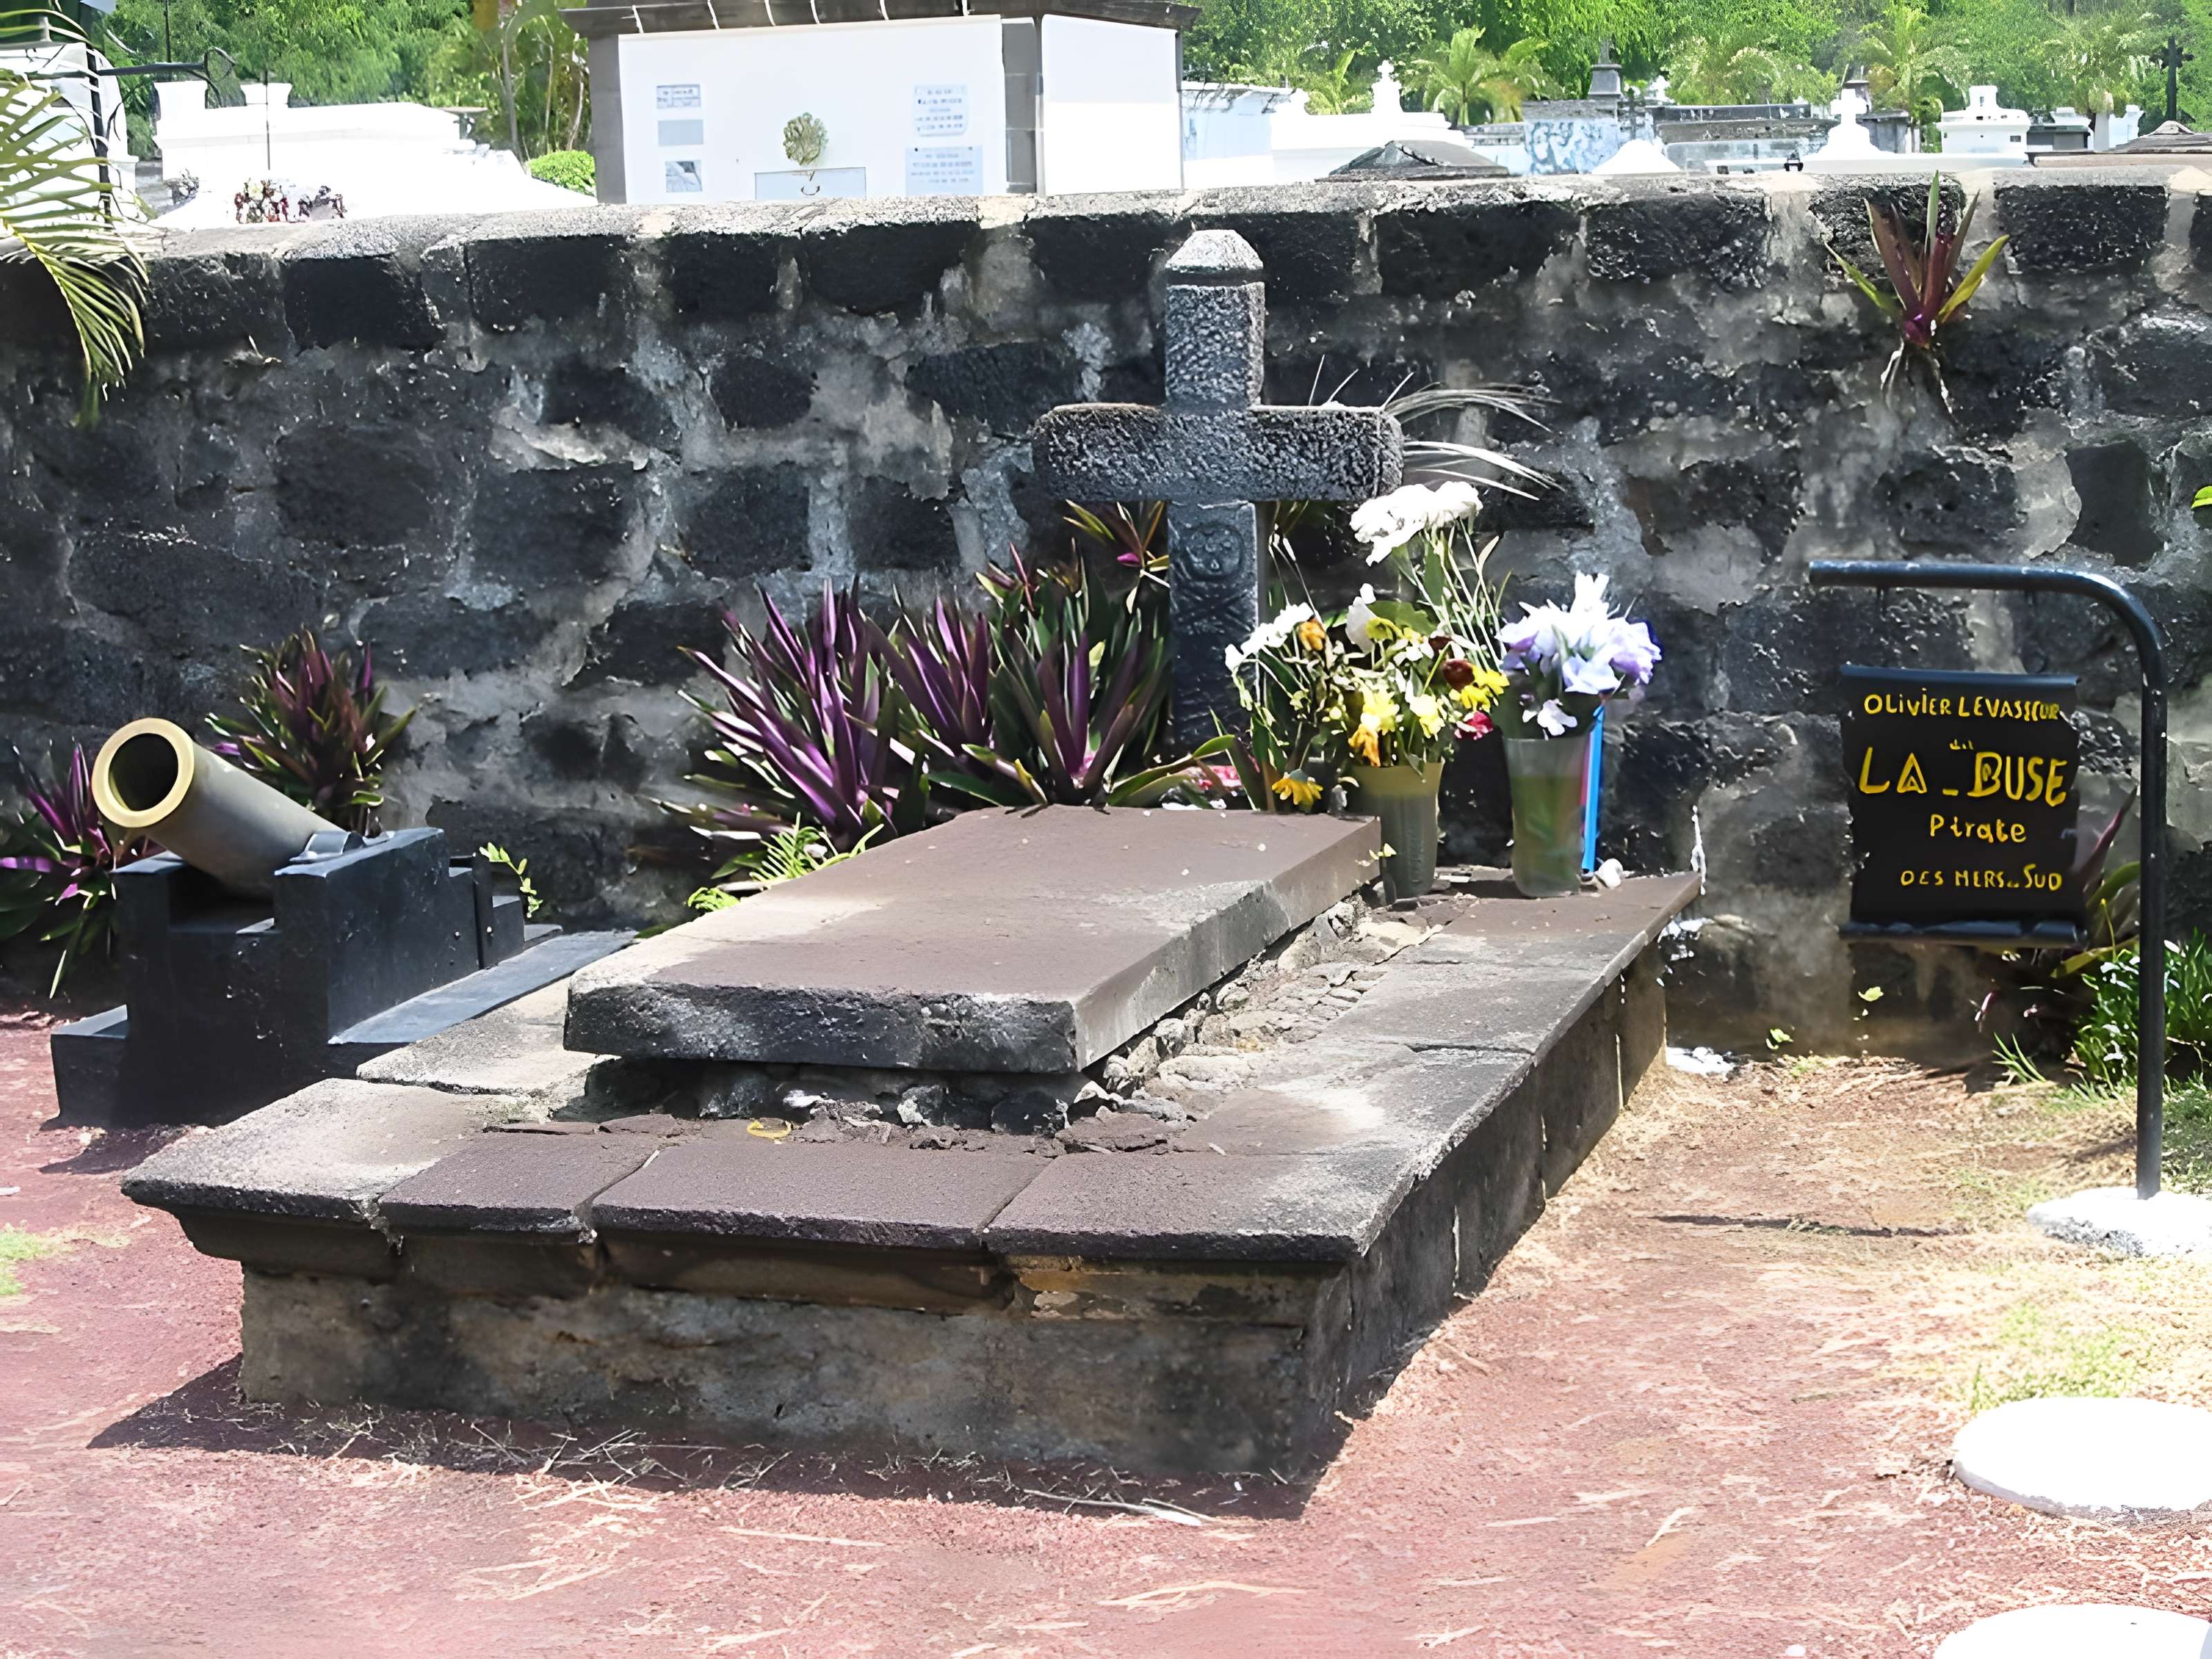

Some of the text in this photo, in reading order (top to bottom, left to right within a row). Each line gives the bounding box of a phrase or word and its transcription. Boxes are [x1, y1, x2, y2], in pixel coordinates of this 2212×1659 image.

[1859, 747, 1928, 795] LA
[1967, 751, 2068, 807] BUSE
[1929, 813, 2027, 844] Pirate
